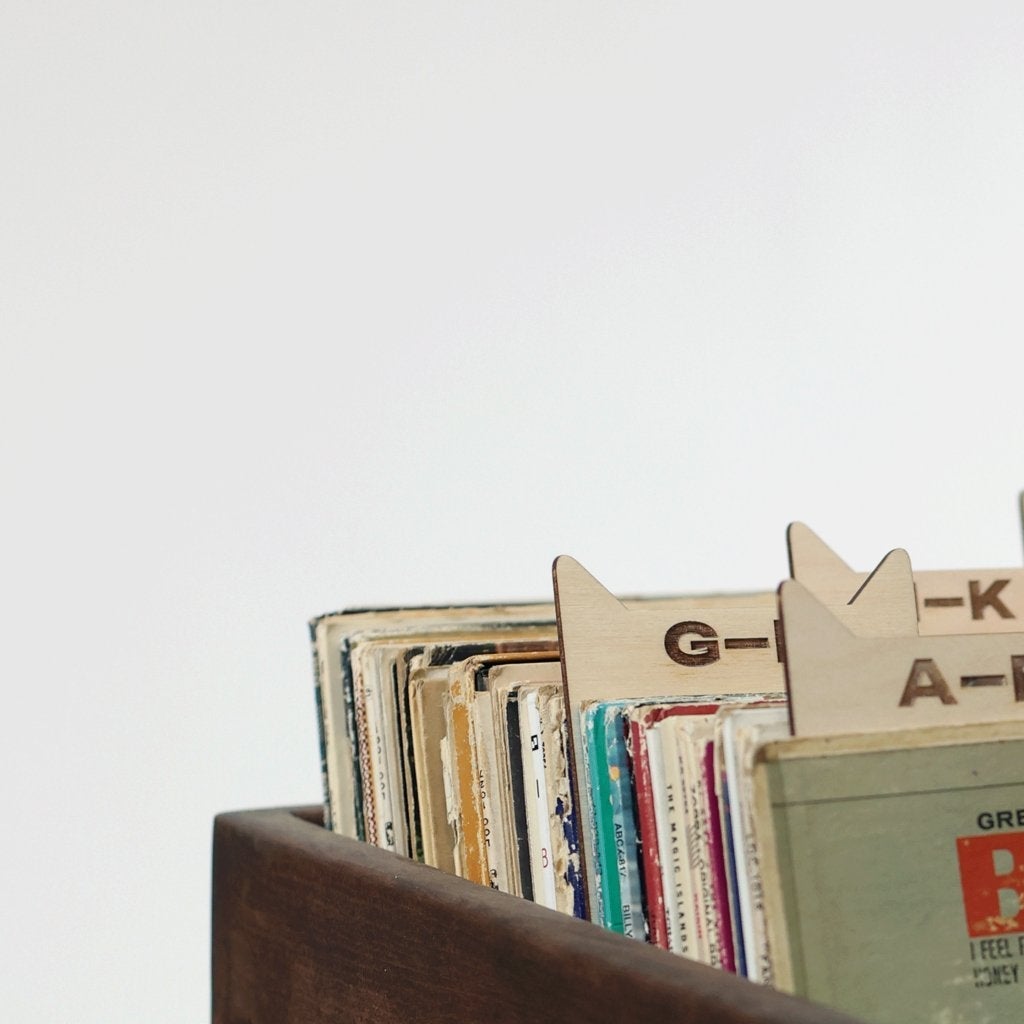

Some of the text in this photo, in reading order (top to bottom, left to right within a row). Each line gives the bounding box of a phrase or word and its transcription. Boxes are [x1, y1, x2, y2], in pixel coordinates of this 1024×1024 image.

[913, 578, 1016, 622] -K
[666, 785, 689, 954] THE MAGIC ISLANDS
[969, 941, 976, 961] I
[979, 937, 1013, 959] FEEL
